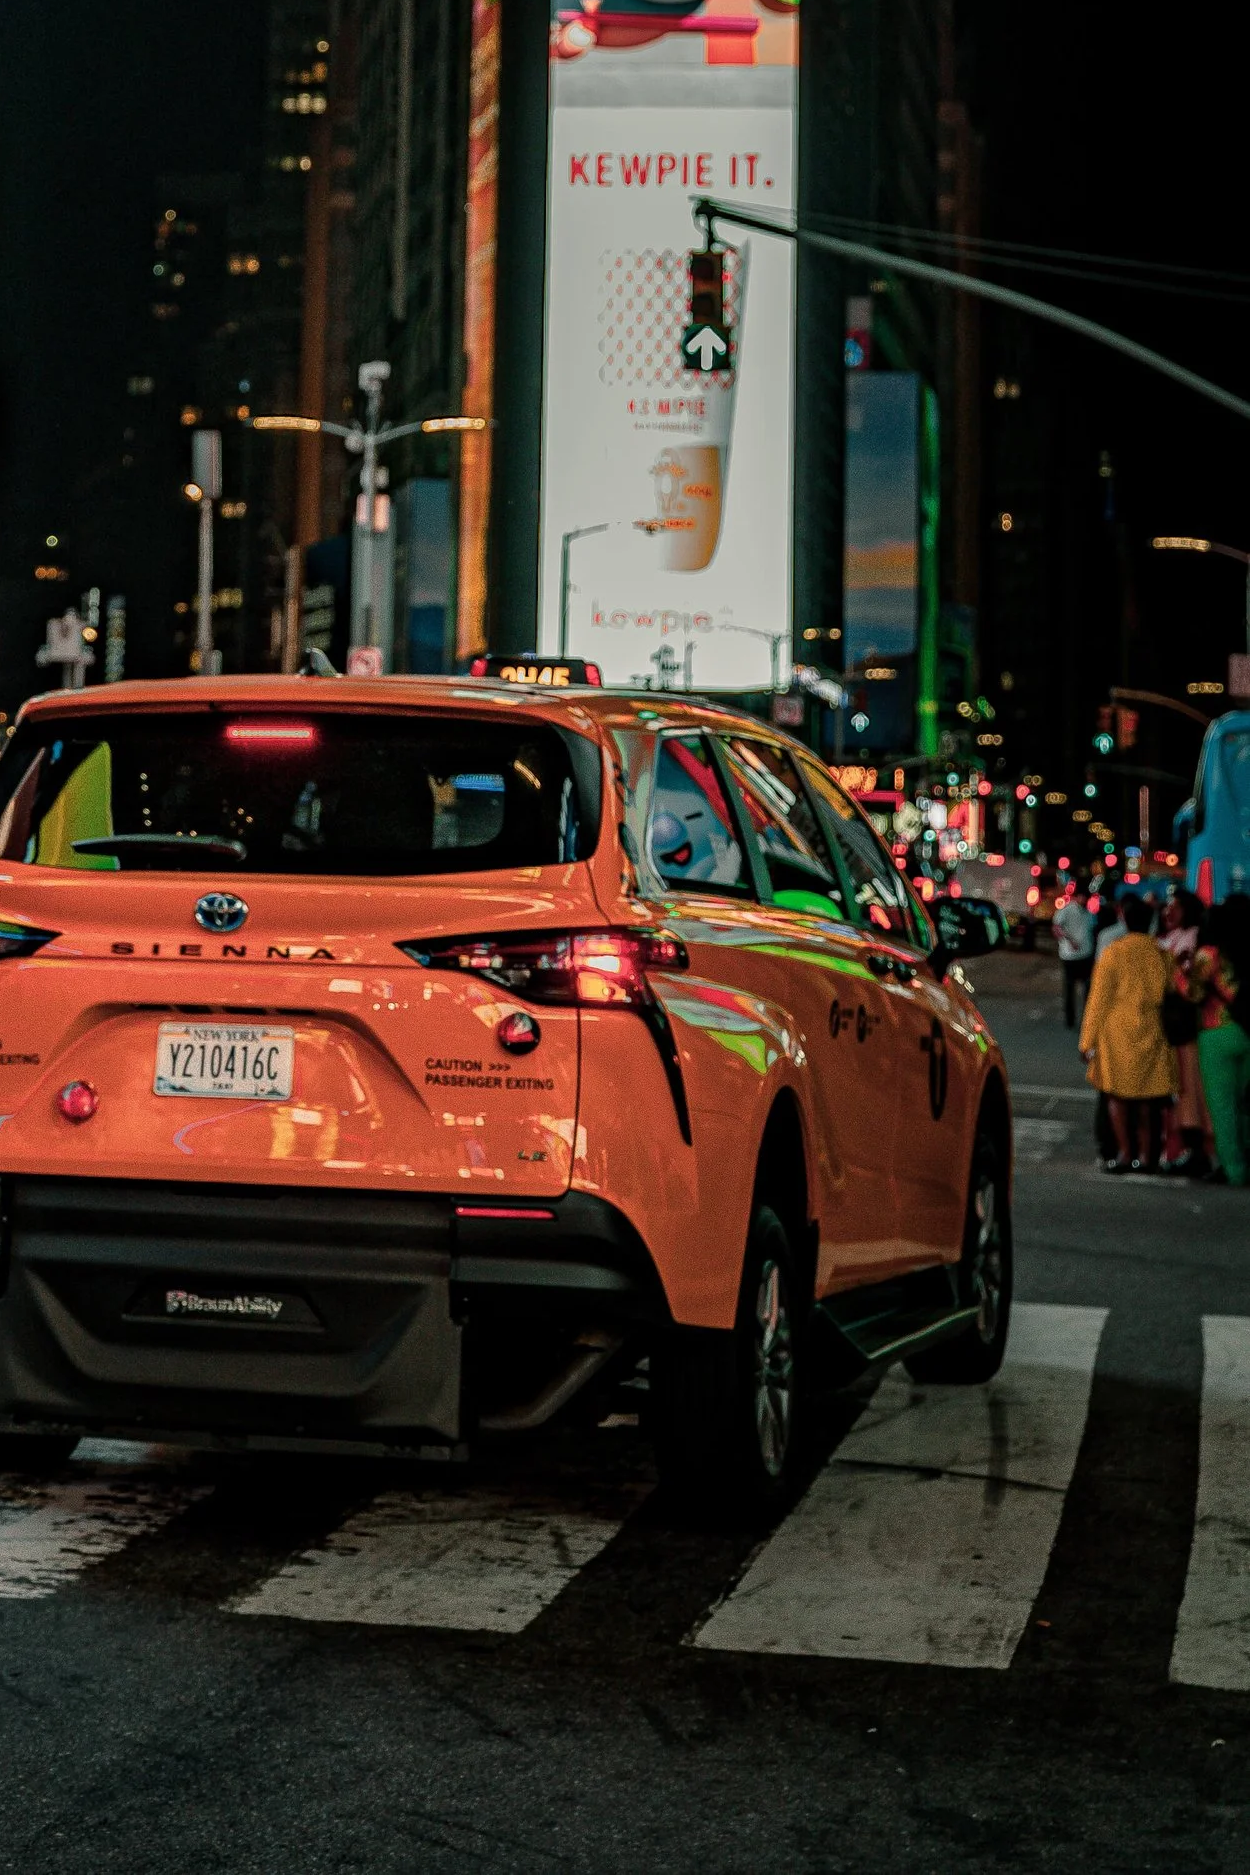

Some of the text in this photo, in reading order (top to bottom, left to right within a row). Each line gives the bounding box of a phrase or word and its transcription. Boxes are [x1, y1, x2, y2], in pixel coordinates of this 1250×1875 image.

[569, 152, 773, 188] KEWPIE IT.
[111, 942, 336, 961] SIENNA
[194, 1029, 260, 1043] NEW YORK
[0, 1053, 40, 1065] EXITING
[170, 1043, 280, 1080] Y210416C
[425, 1057, 482, 1071] CAUTION
[425, 1072, 554, 1090] PASSENGER EXITING
